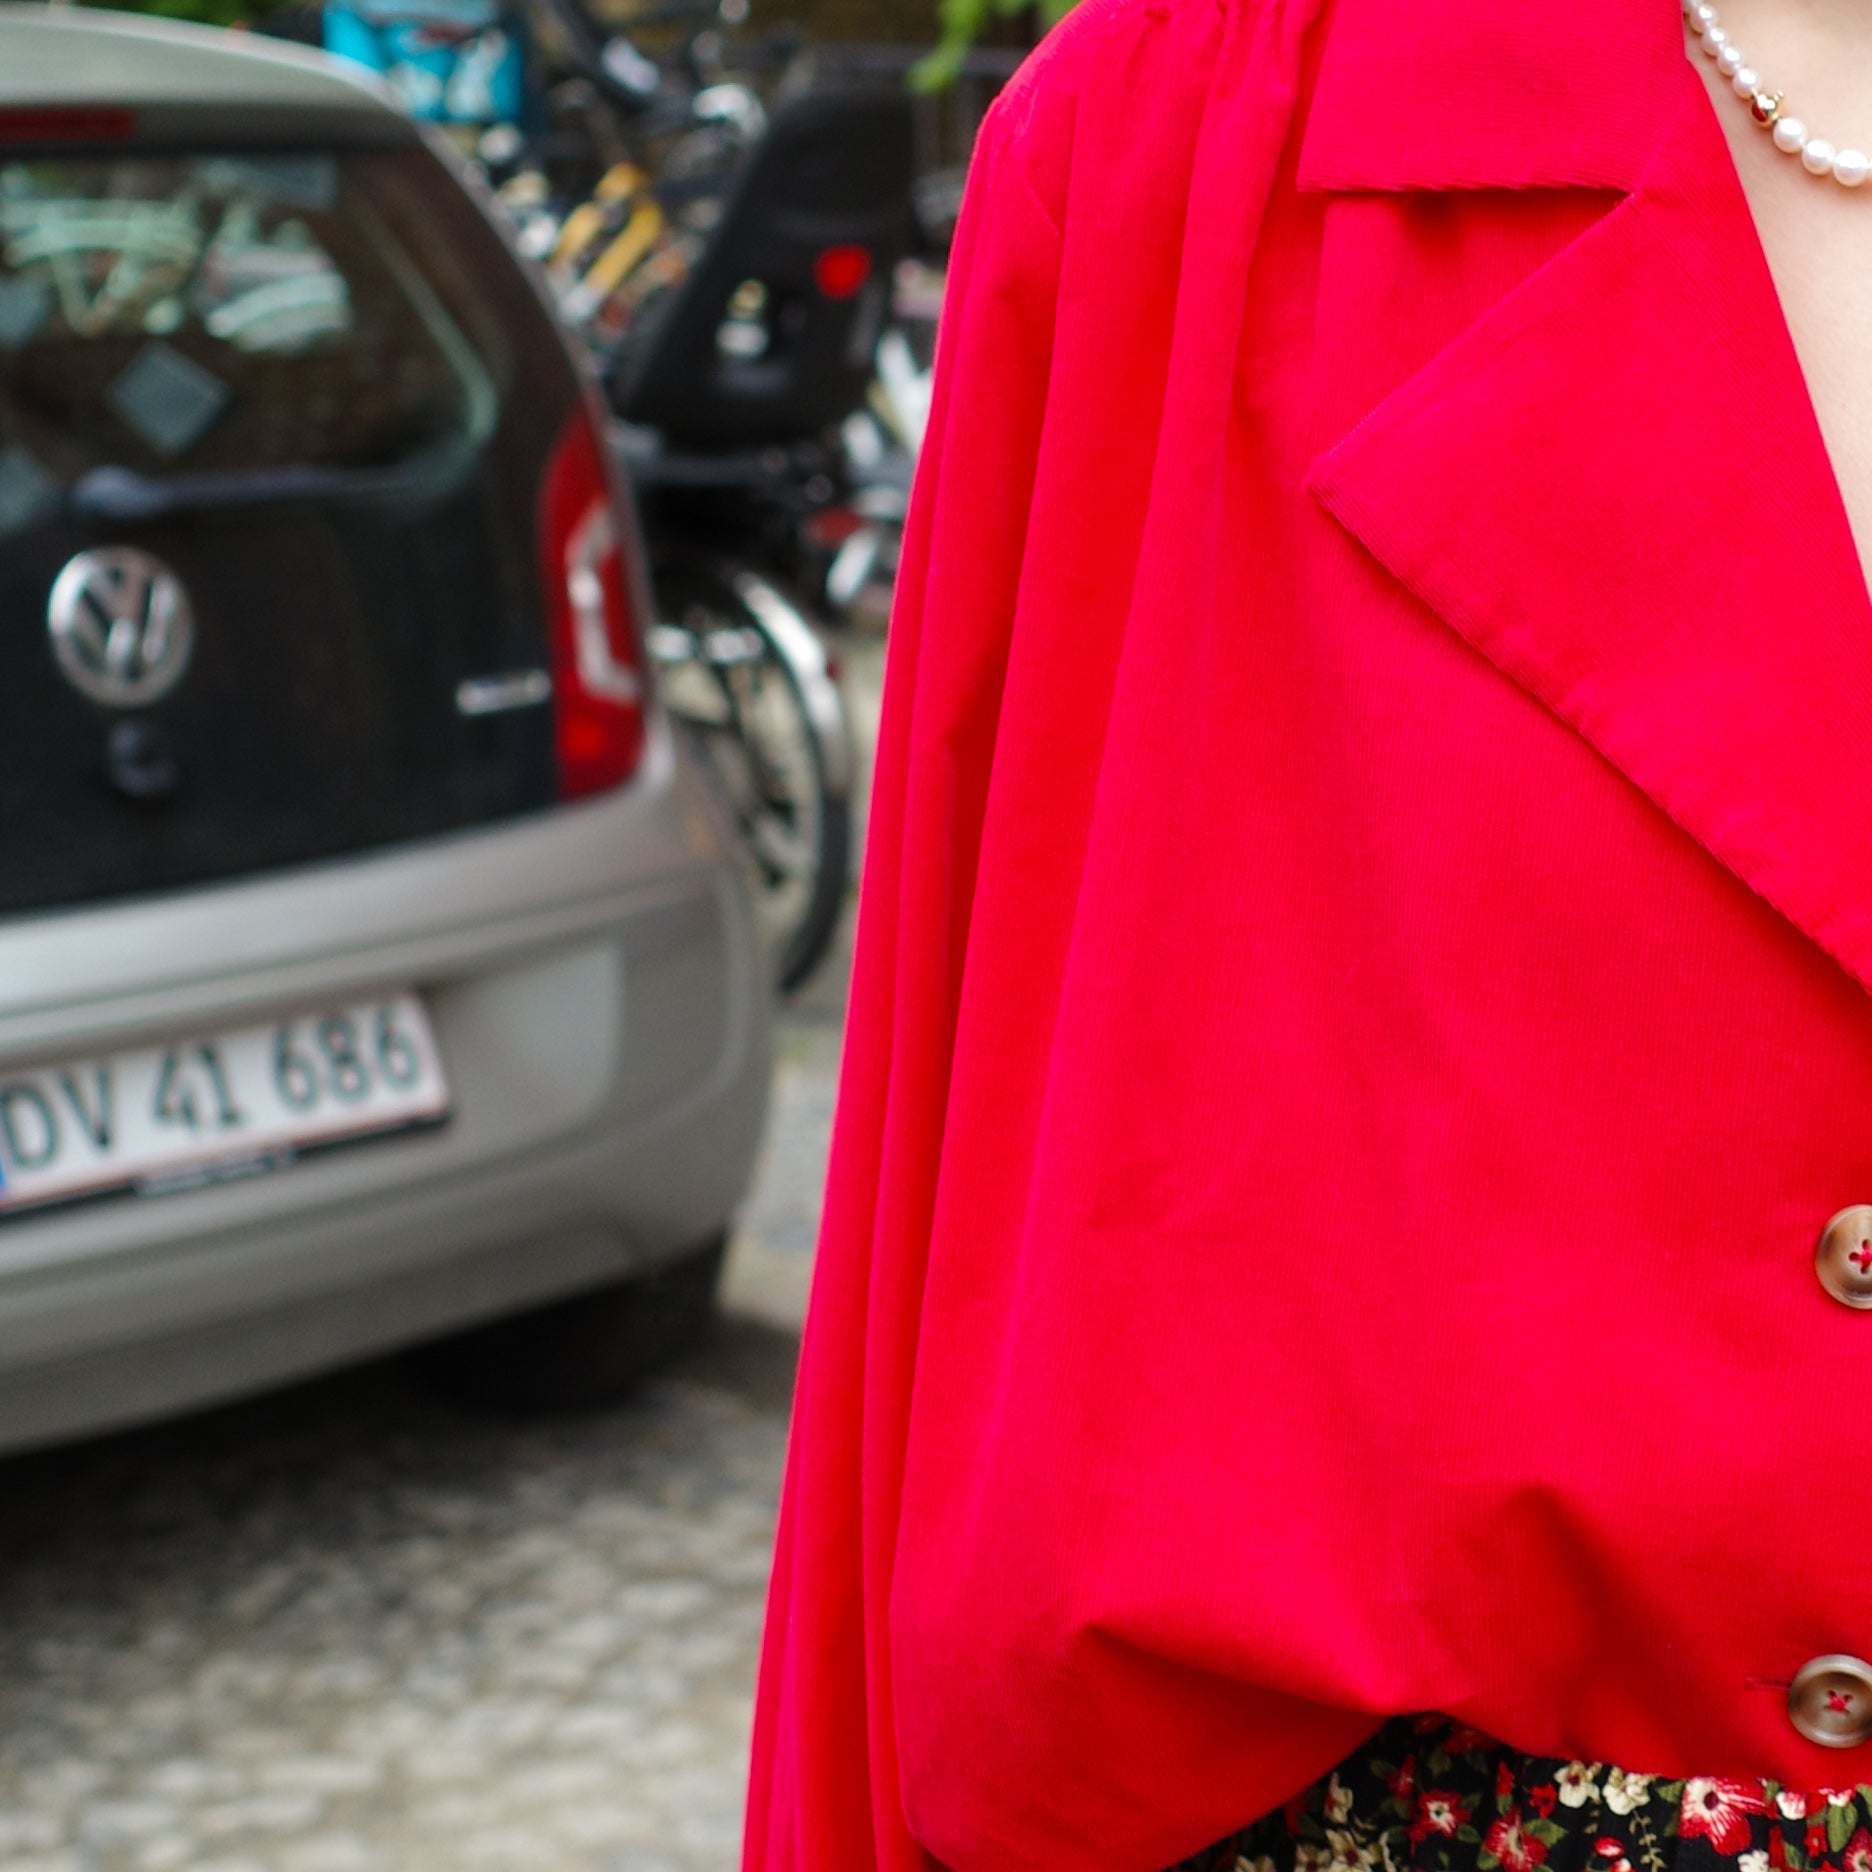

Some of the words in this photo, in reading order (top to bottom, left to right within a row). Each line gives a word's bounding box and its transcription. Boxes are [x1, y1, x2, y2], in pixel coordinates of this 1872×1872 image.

[1, 1063, 112, 1169] DV
[152, 1043, 243, 1132] 41
[273, 1006, 421, 1111] 686
